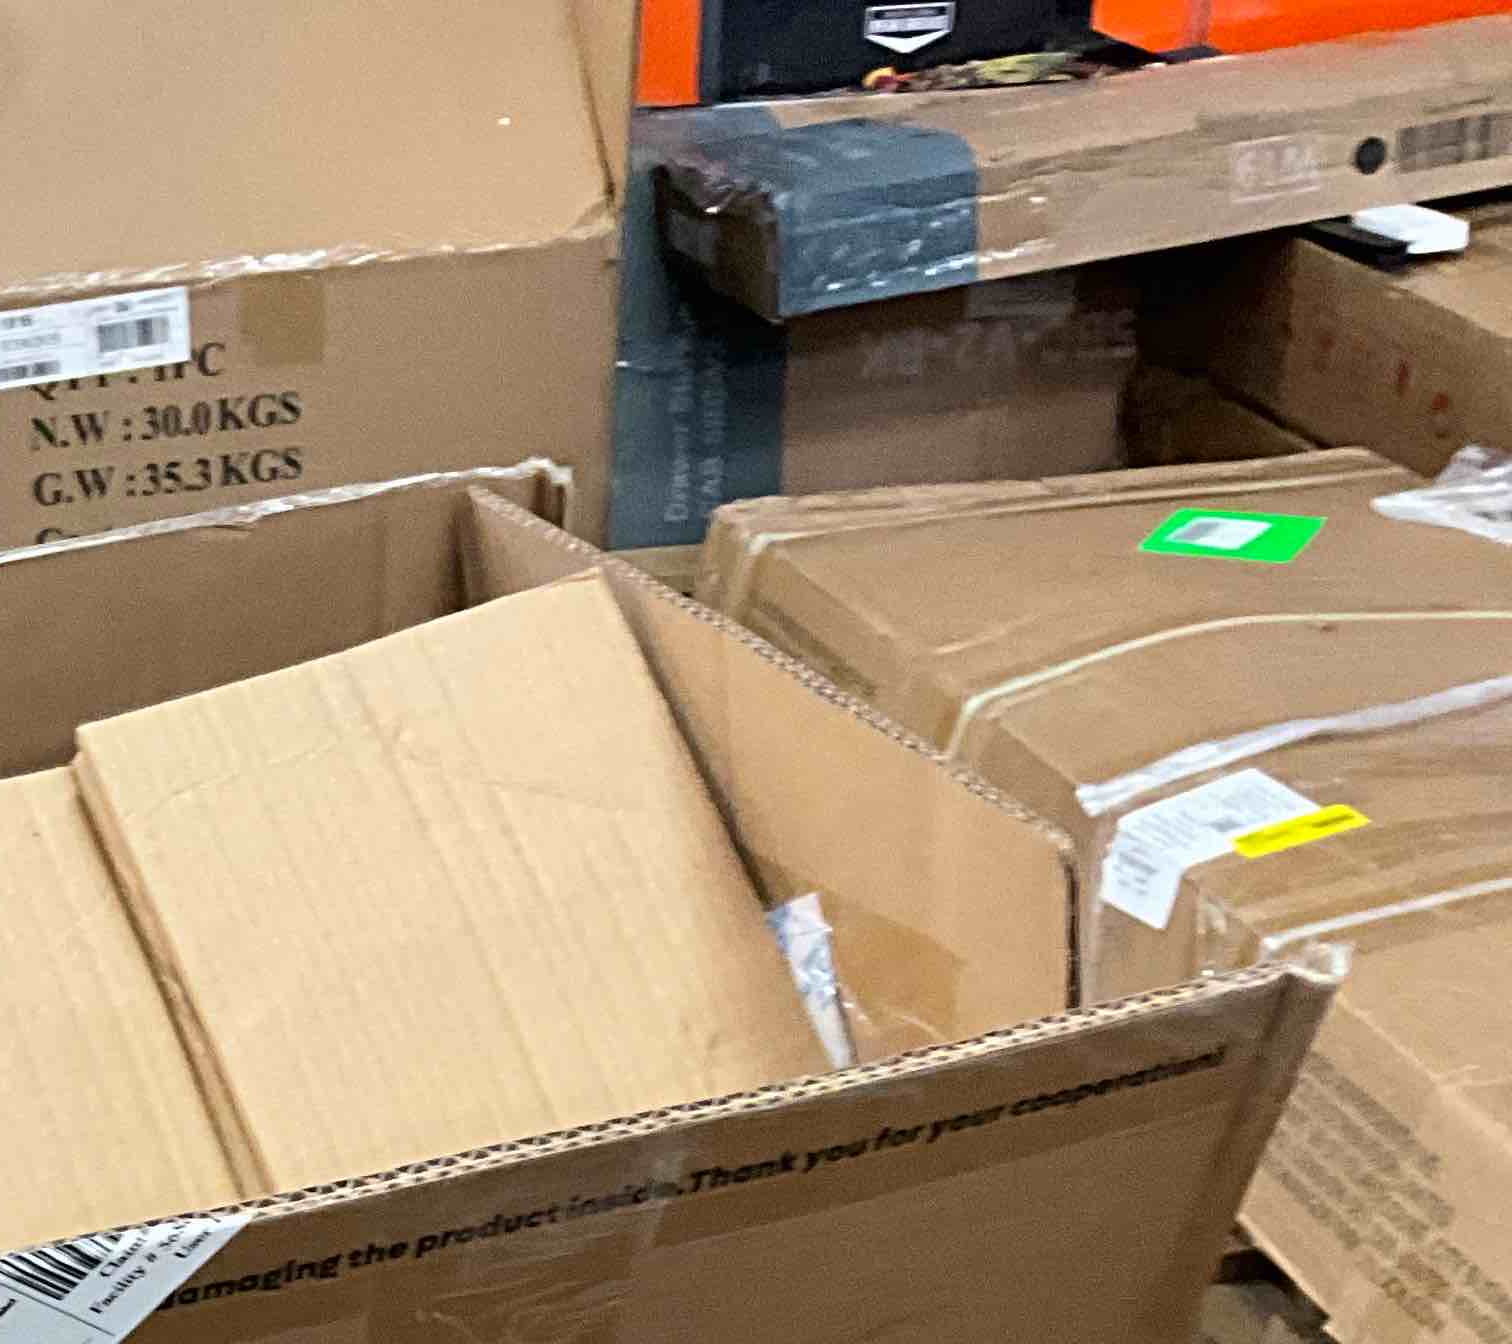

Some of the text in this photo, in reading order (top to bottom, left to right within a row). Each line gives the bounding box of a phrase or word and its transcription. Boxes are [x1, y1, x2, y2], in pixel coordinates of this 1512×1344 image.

[347, 1237, 410, 1269] the
[415, 1205, 560, 1260] product
[690, 1150, 795, 1192] Thank
[802, 1138, 870, 1175] you
[873, 1123, 926, 1152] for
[926, 1104, 1006, 1144] your
